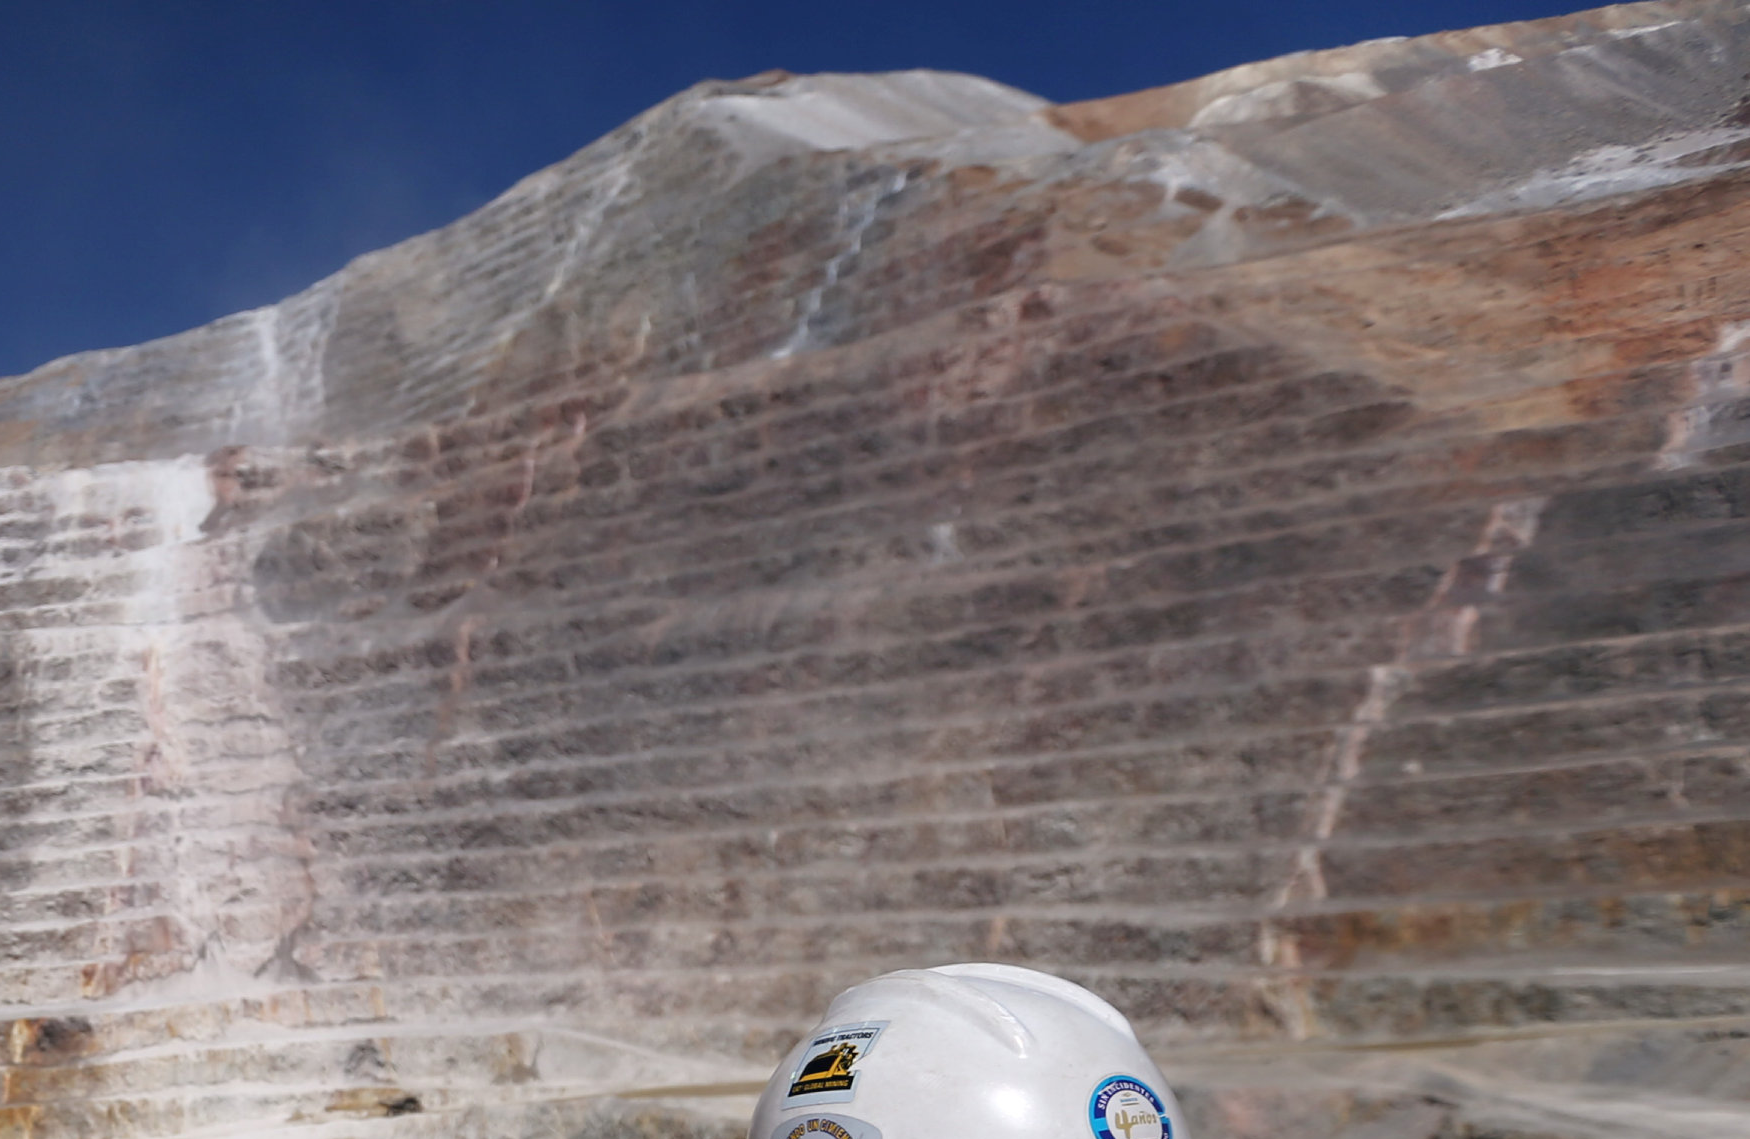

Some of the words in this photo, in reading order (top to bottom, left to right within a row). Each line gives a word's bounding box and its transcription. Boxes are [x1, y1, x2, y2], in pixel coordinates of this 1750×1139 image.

[837, 1032, 874, 1041] TRACTORS
[825, 1079, 849, 1087] MINING
[1097, 1093, 1110, 1110] SIN
[1107, 1082, 1155, 1103] INCIDENTES
[806, 1118, 820, 1132] UN
